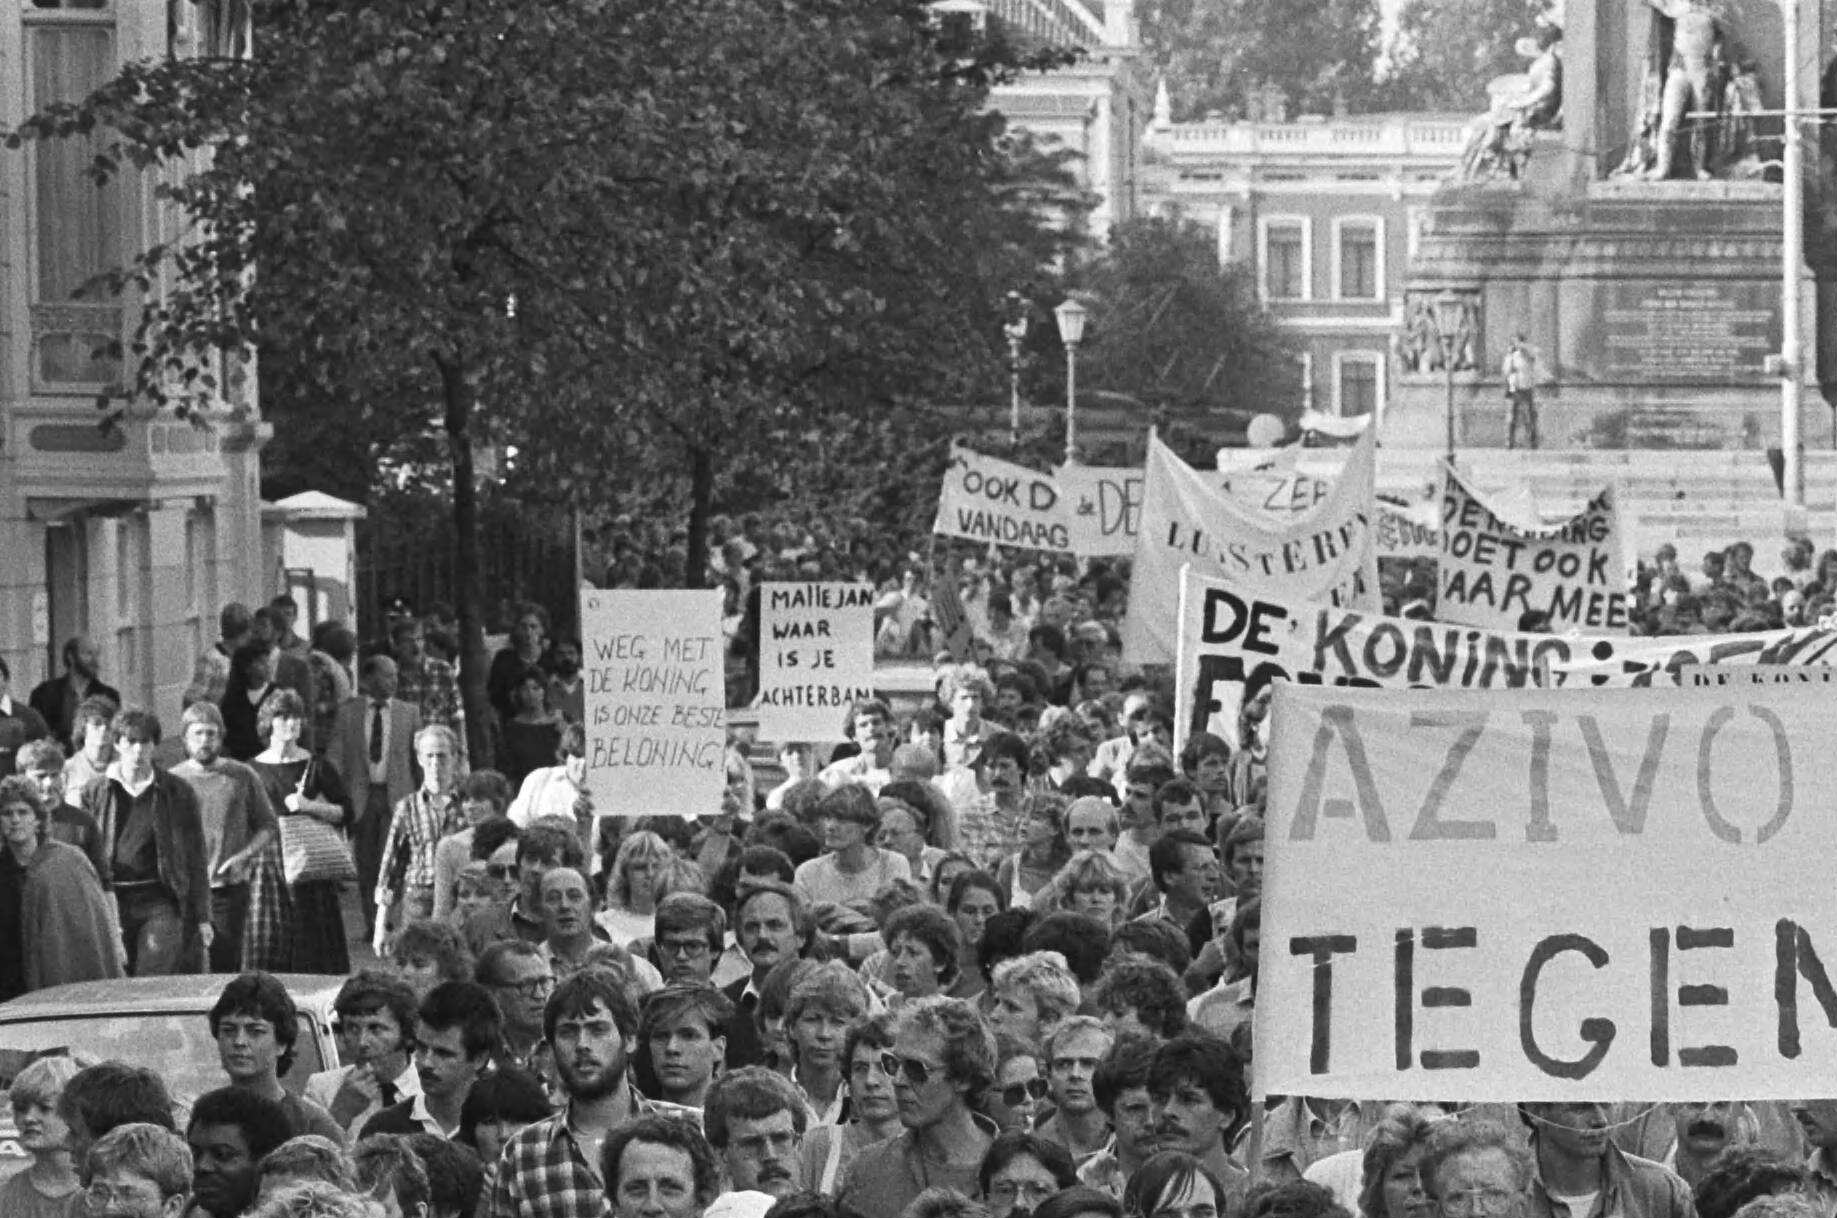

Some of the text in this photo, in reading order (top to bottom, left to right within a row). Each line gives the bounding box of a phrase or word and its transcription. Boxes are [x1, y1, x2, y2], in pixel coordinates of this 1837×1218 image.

[963, 470, 1020, 507] OOK
[957, 507, 1069, 549] VANDAAG
[1443, 530, 1526, 570] OET
[1533, 548, 1608, 585] OOK
[1443, 568, 1629, 628] AAR MEE
[772, 619, 831, 640] WAAR
[594, 635, 714, 662] WEG MET
[777, 649, 836, 669] IS JE
[590, 665, 709, 696] DE KONING
[594, 705, 726, 729] IS ONZE BESTE
[1288, 704, 1795, 845] AZIVO
